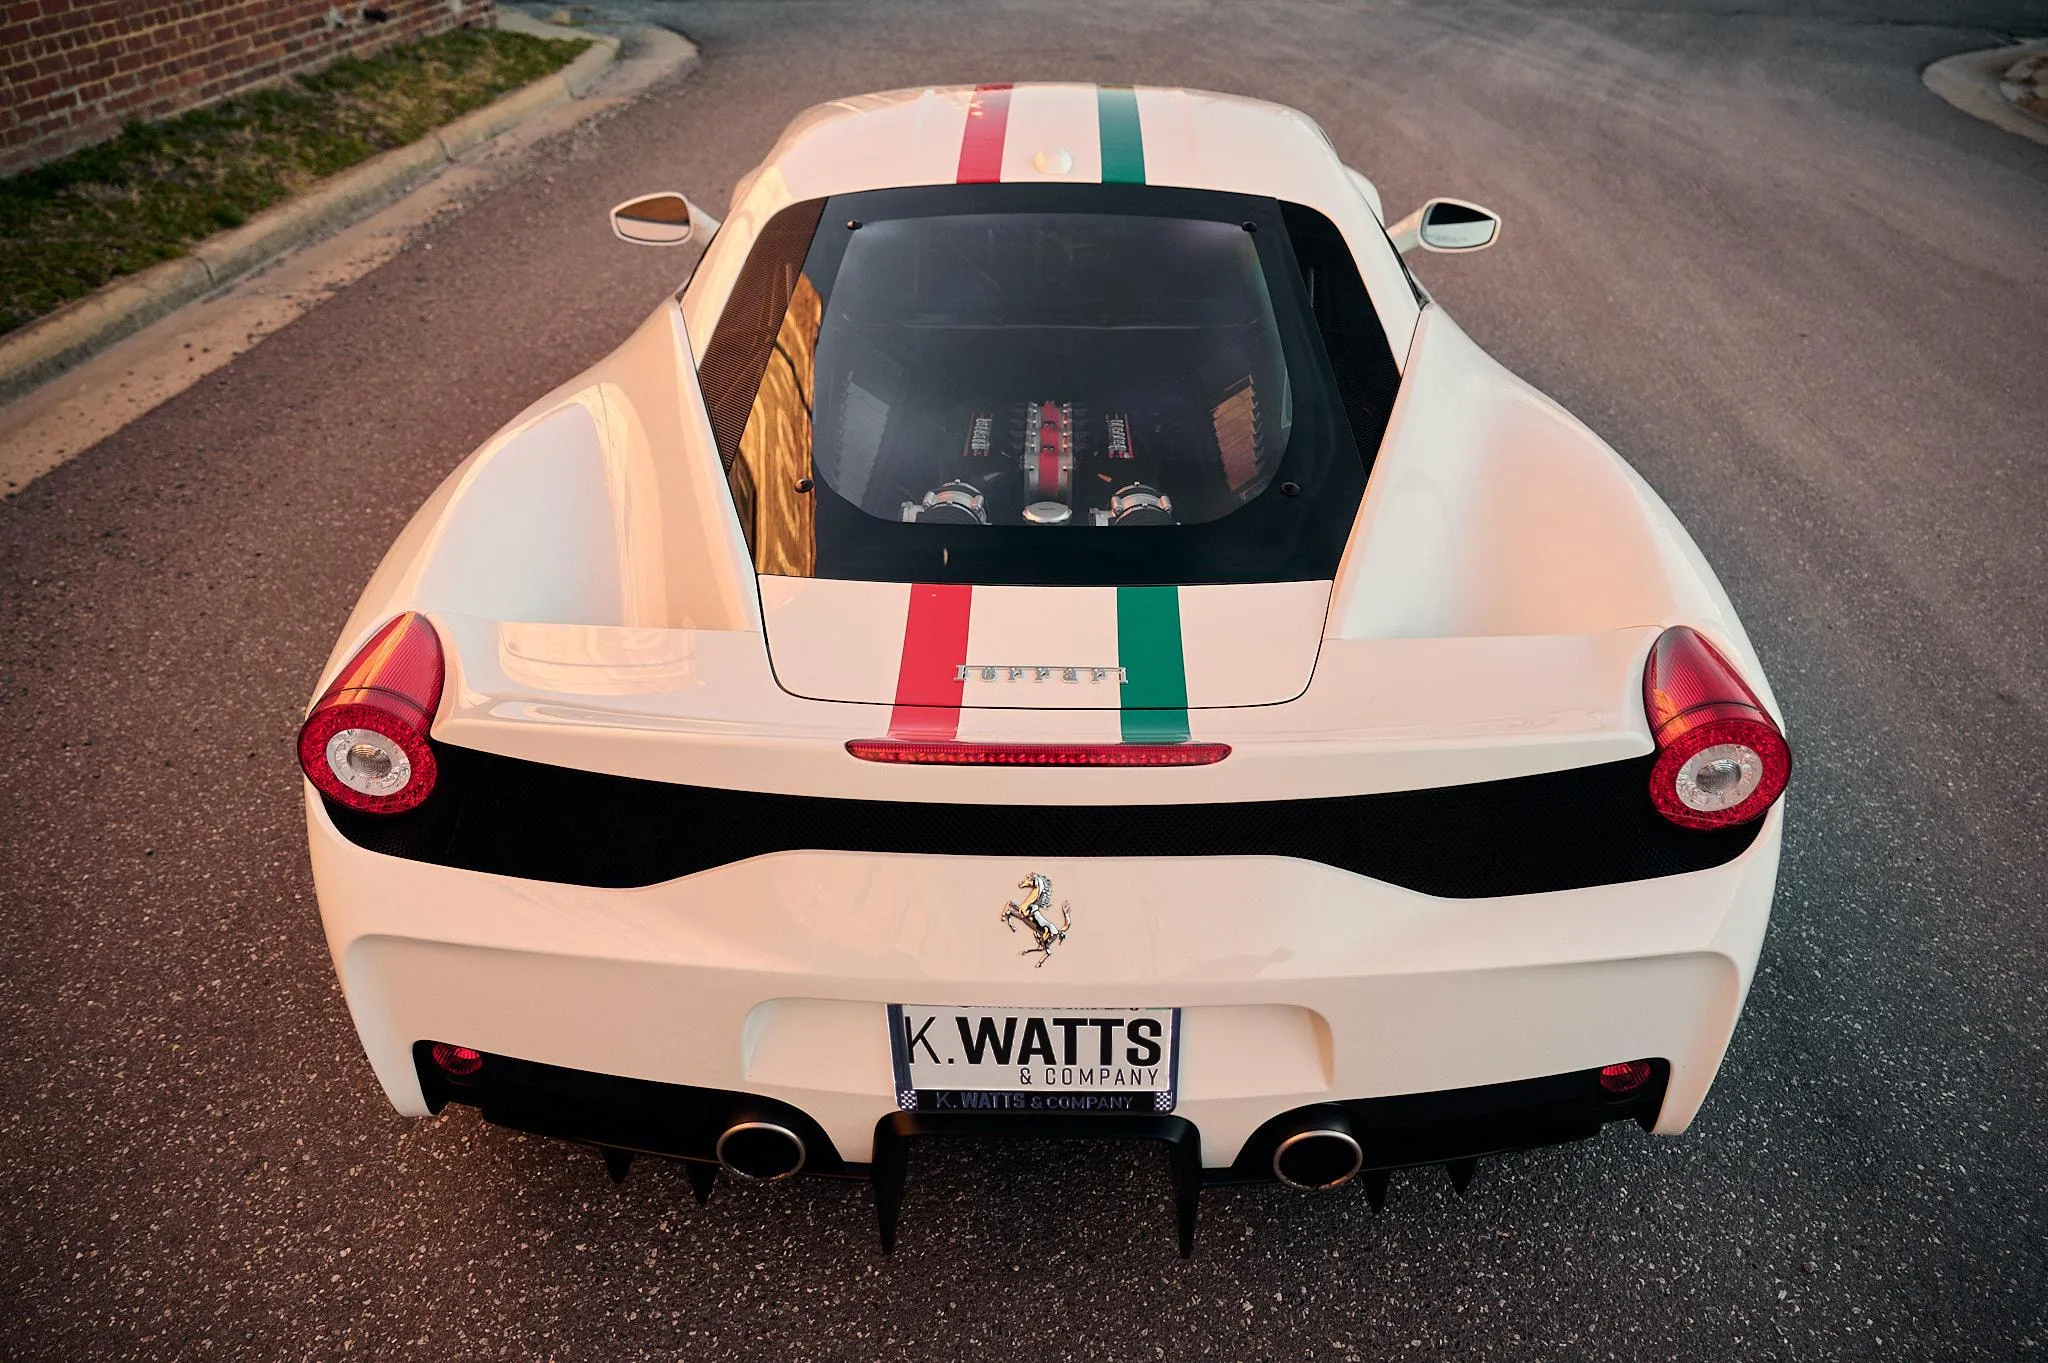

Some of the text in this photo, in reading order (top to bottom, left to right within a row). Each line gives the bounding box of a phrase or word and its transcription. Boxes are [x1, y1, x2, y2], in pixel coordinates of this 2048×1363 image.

[1020, 1067, 1158, 1086] & COMPANY
[1031, 1095, 1043, 1109] &
[1046, 1095, 1134, 1110] COMPANY
